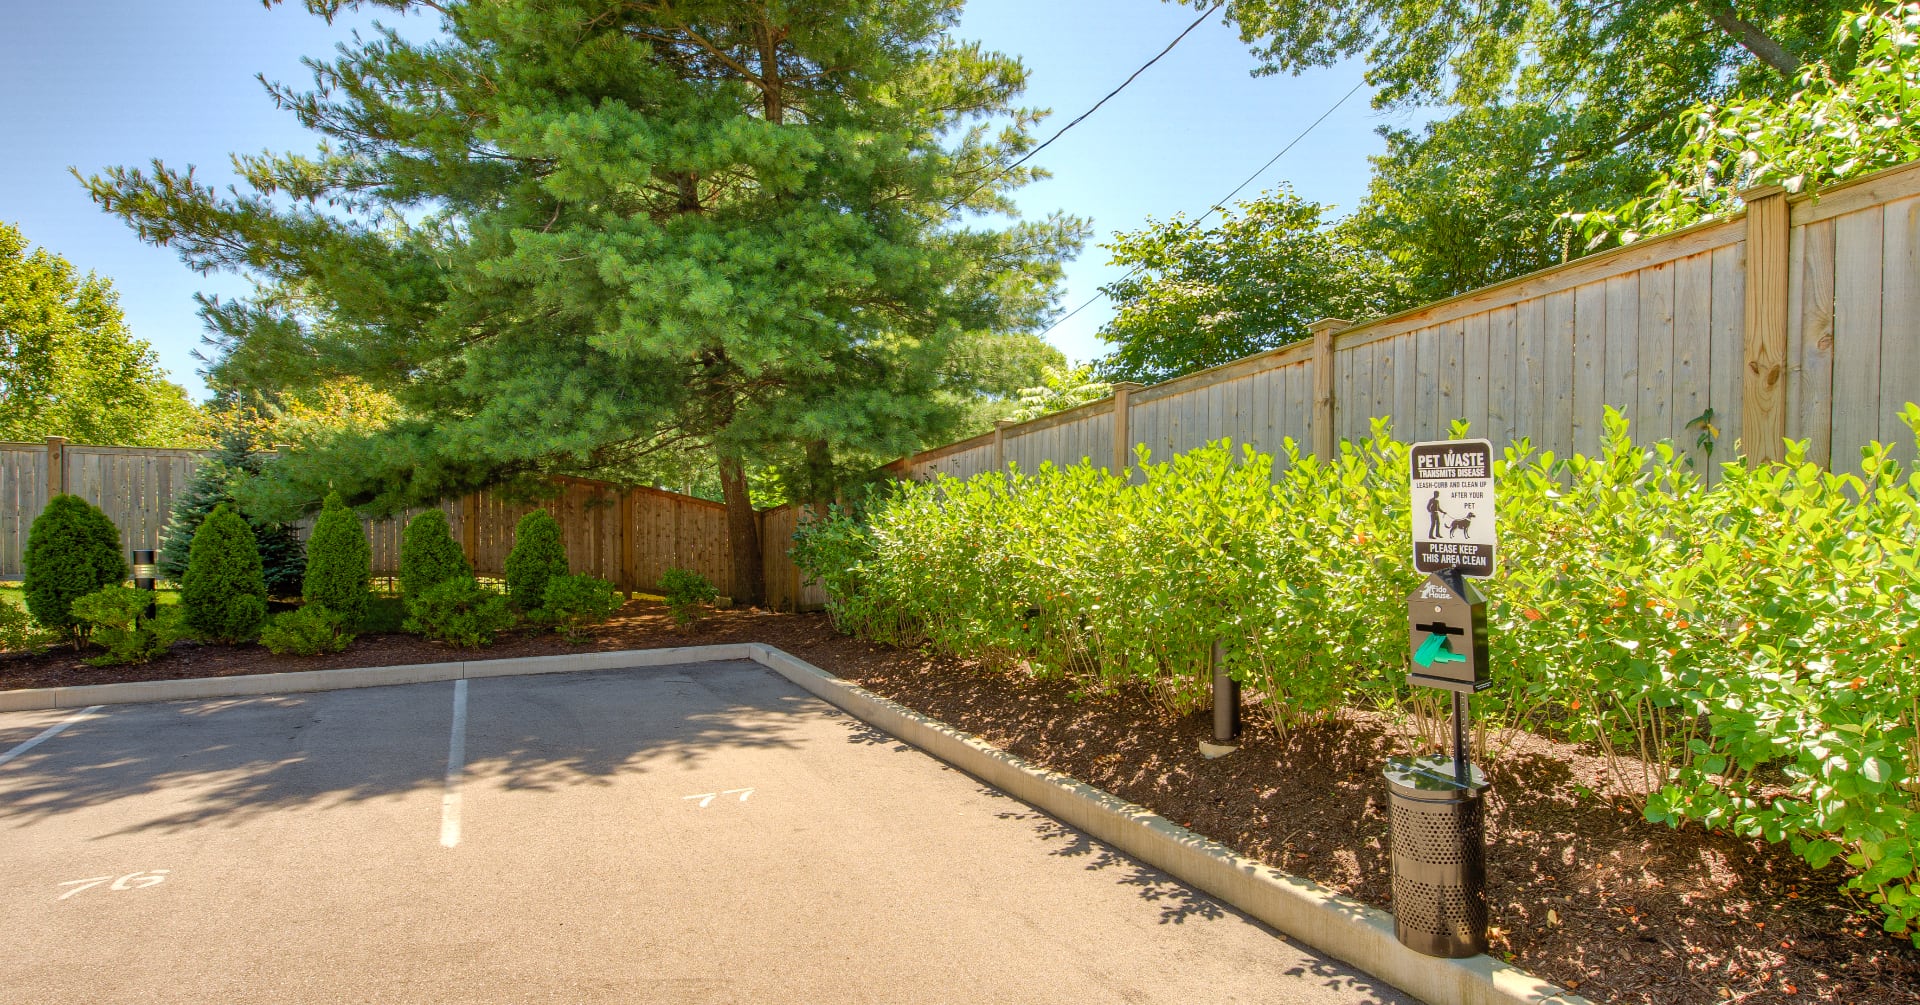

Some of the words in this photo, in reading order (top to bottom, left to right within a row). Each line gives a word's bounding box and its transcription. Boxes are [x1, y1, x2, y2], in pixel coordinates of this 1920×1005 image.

[1418, 455, 1440, 468] PET
[1444, 453, 1484, 468] WASTE
[1419, 468, 1456, 478] TRANSMITS
[1458, 468, 1484, 477] DISEASE
[1430, 544, 1457, 554] PLEASE
[1460, 544, 1478, 554] KEEP
[1422, 553, 1439, 563] THIS
[1441, 554, 1460, 564] AREA
[1462, 555, 1486, 566] CLEAN
[682, 787, 756, 808] 77
[58, 868, 170, 901] 76
